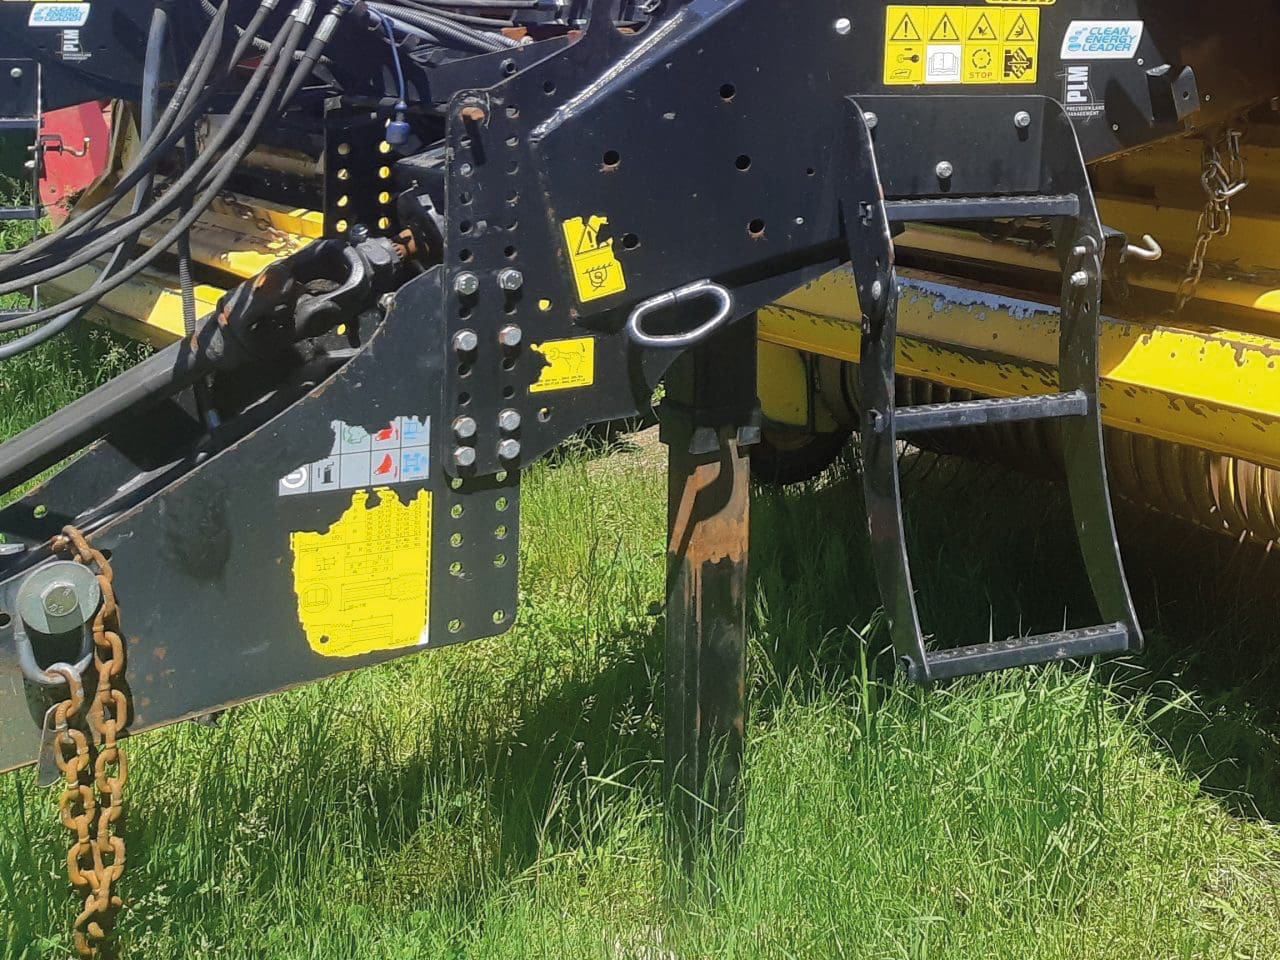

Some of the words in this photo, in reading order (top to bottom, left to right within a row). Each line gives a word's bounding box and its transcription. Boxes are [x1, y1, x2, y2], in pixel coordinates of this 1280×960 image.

[1089, 26, 1130, 36] CLEAN
[63, 29, 80, 52] PLM
[1085, 35, 1136, 44] ENERGY
[1082, 43, 1131, 52] LEADER
[969, 71, 992, 79] STOP
[1066, 66, 1089, 103] PLM
